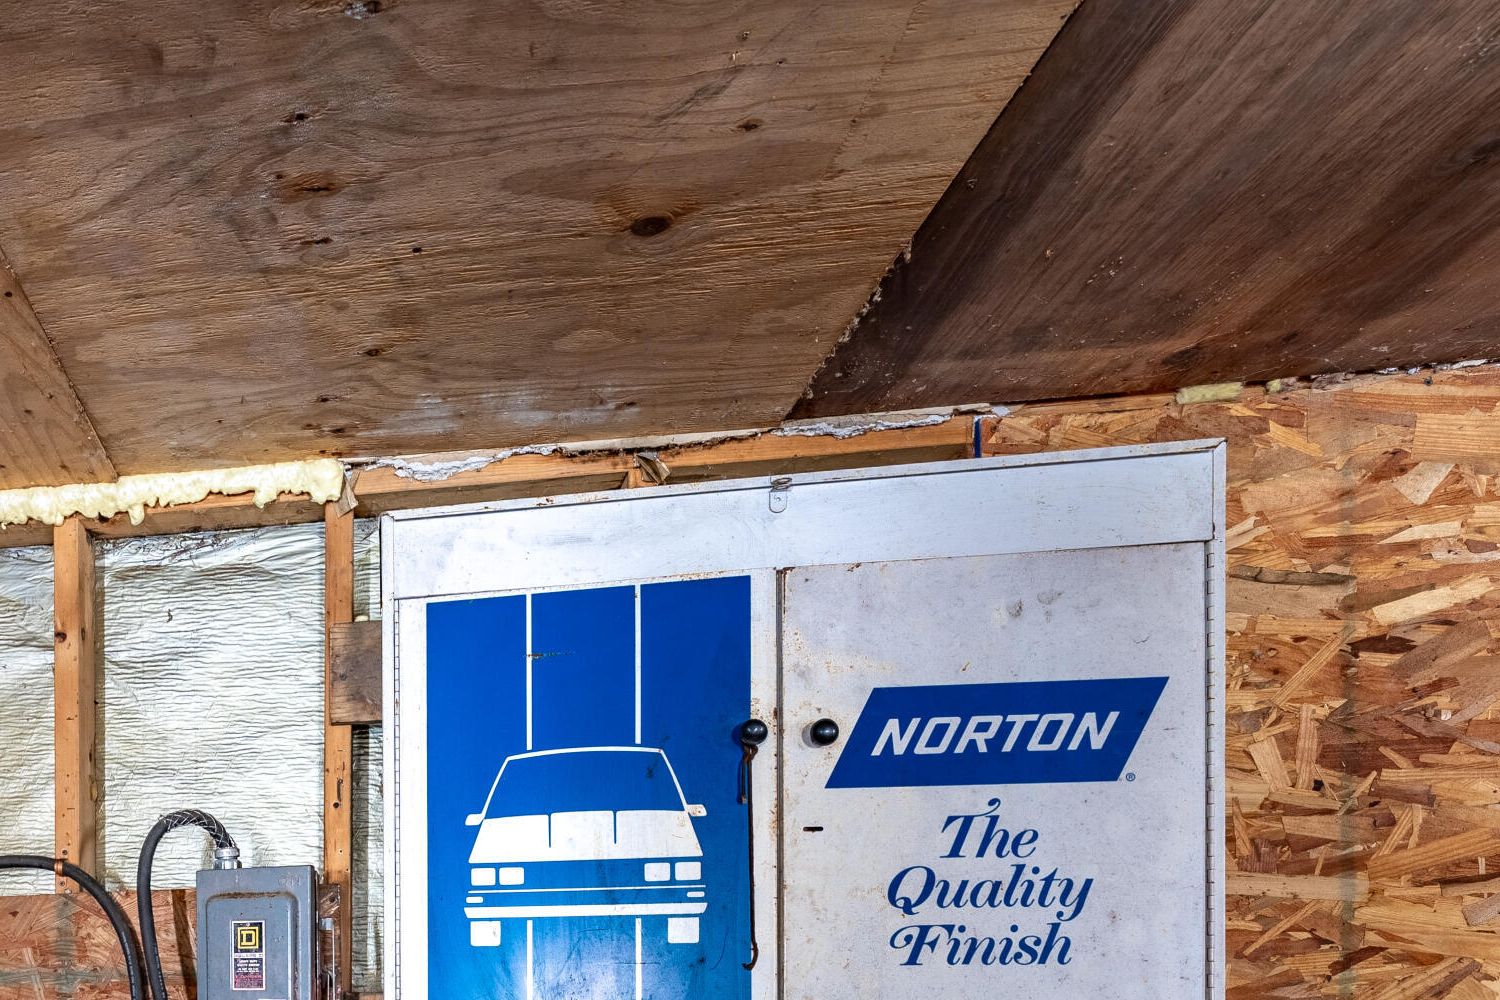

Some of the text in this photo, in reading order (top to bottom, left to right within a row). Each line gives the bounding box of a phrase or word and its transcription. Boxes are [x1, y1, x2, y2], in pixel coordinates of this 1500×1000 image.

[870, 711, 1121, 757] NORTON
[939, 798, 1039, 858] The
[887, 864, 1094, 922] Quality
[889, 922, 1073, 967] Finish
